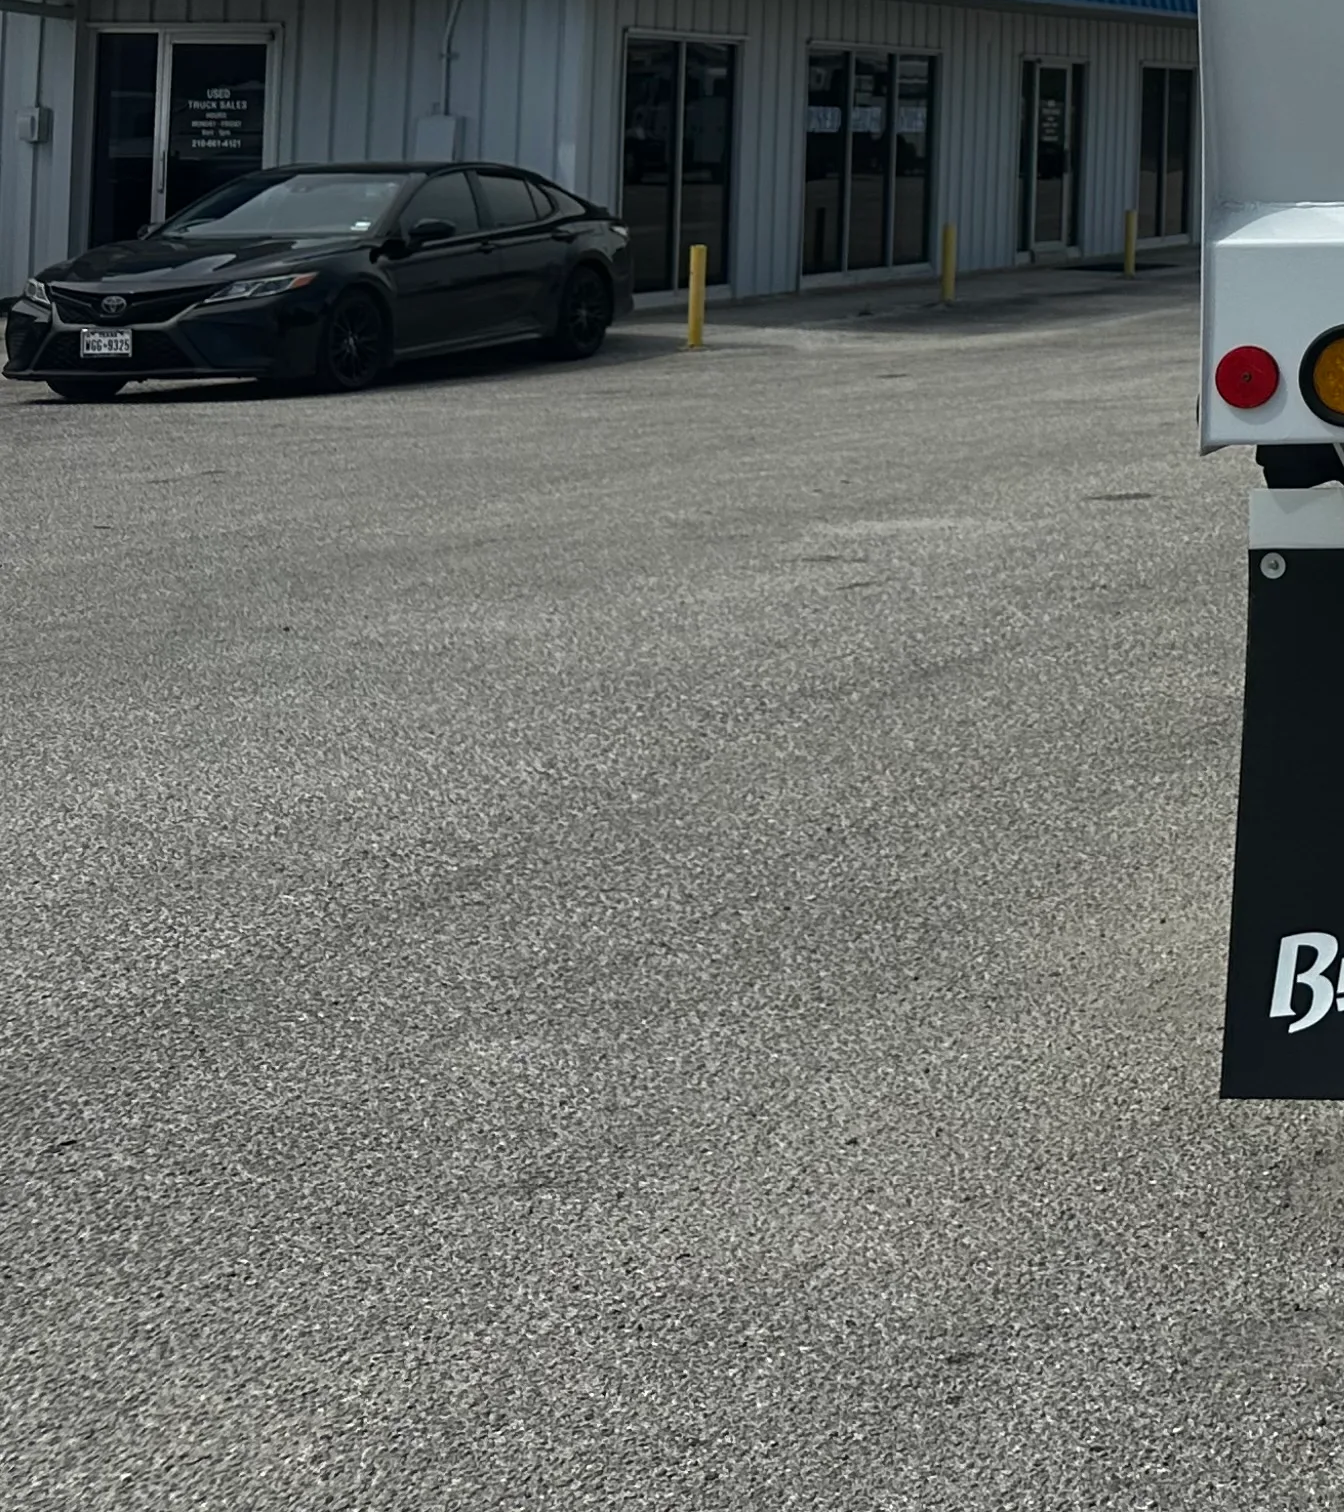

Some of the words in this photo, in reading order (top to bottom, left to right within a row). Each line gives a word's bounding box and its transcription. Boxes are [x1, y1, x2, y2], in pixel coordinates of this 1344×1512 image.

[207, 88, 231, 99] USED
[188, 100, 217, 110] TRUCK
[219, 100, 248, 110] SALES
